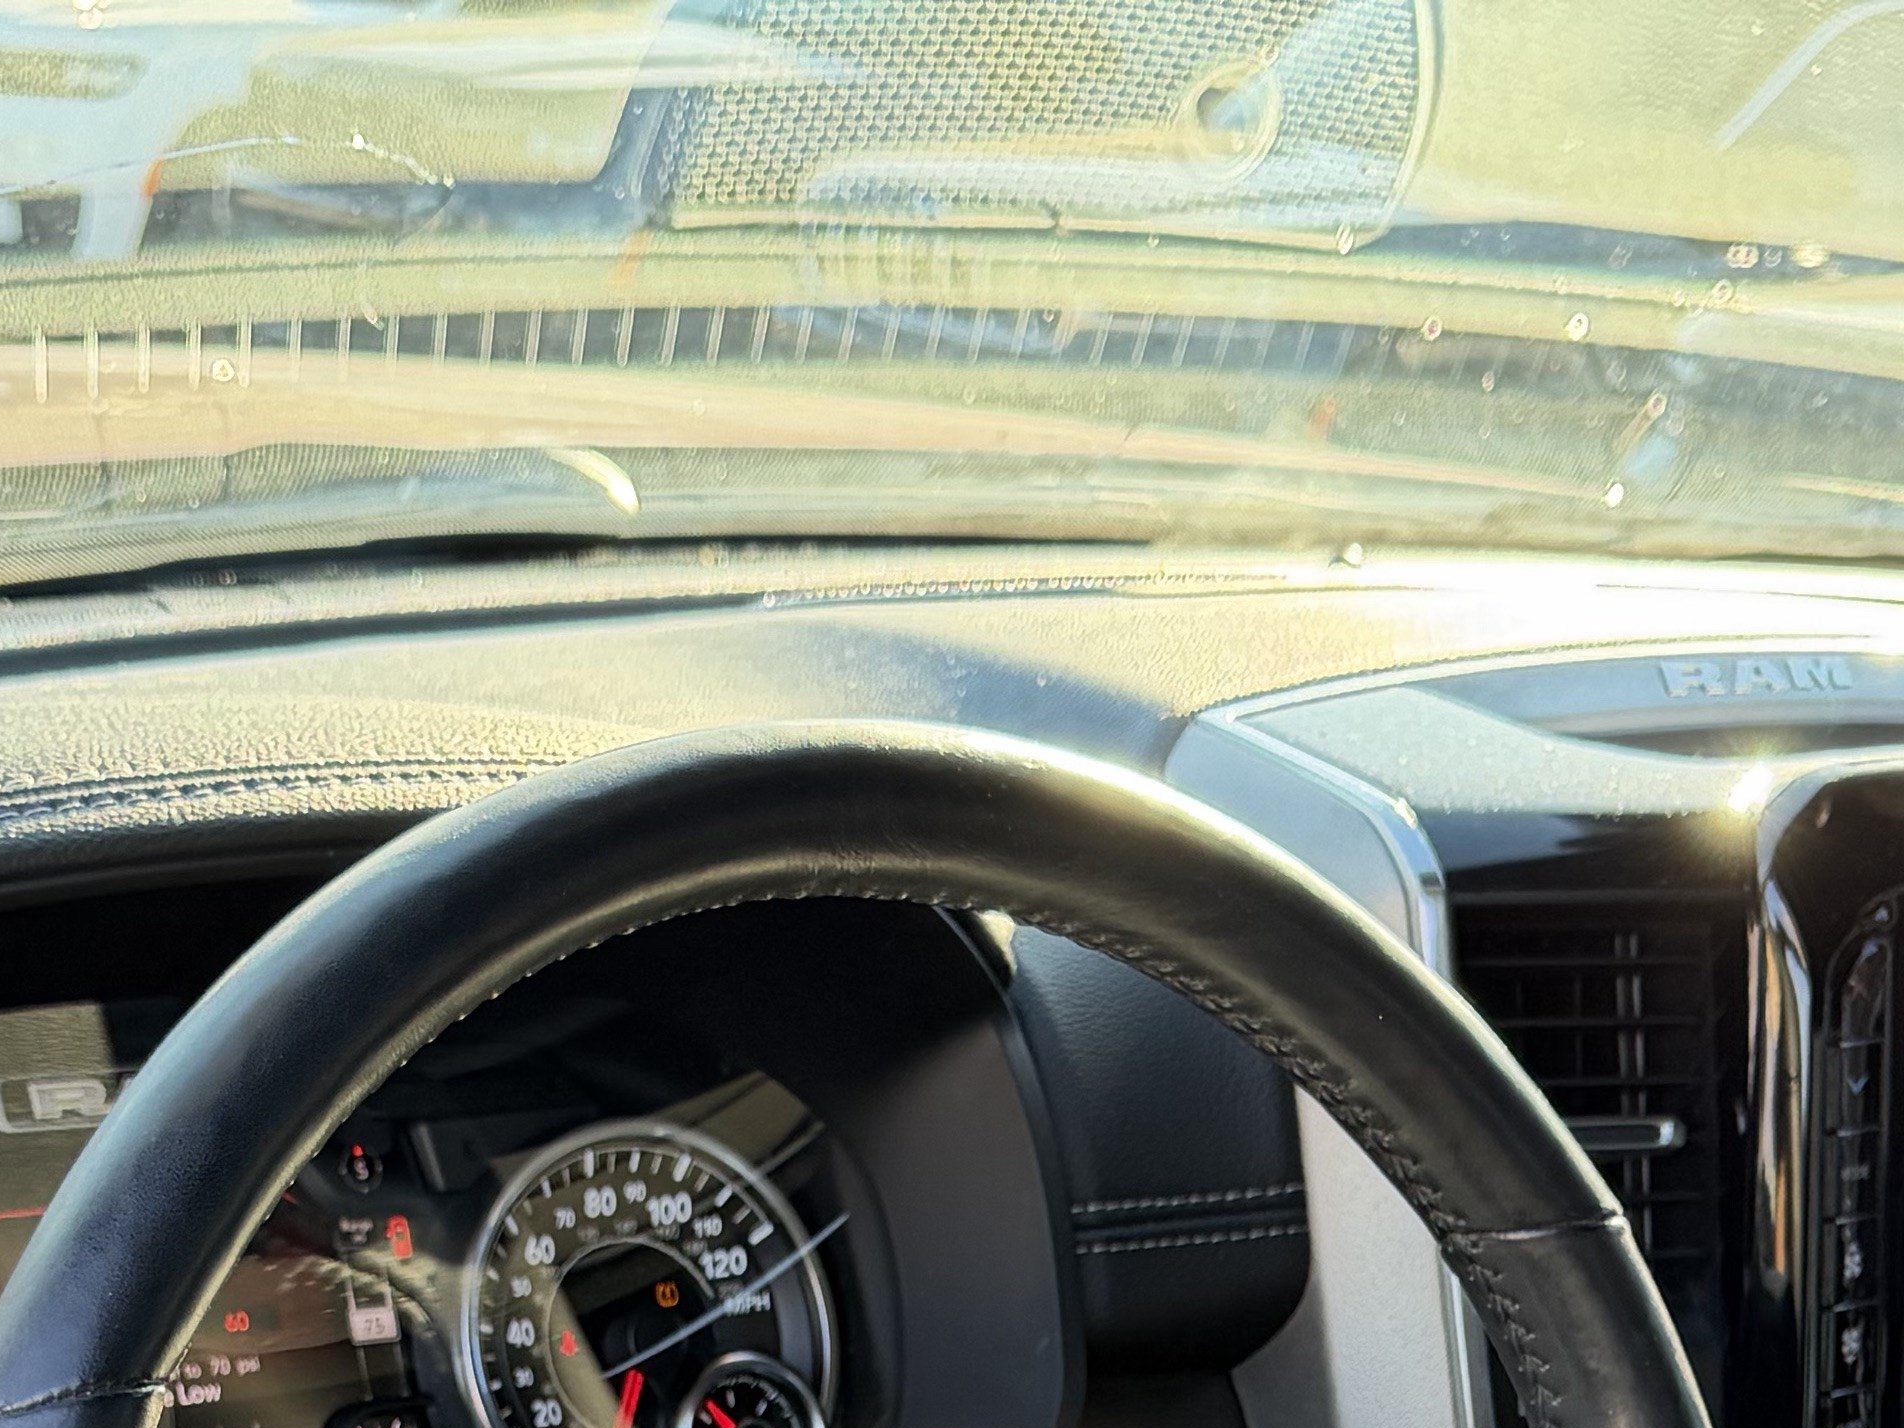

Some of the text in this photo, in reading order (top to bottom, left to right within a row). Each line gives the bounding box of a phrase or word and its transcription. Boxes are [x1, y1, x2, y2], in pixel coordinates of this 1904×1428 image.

[1658, 656, 1853, 698] RAM
[583, 1185, 617, 1219] 80
[623, 1179, 647, 1203] 90
[553, 1206, 577, 1230] 70
[646, 1190, 693, 1226] 100
[692, 1212, 723, 1238] 110
[524, 1234, 556, 1266] 60
[700, 1244, 748, 1281] 120
[506, 1317, 536, 1348] 40
[529, 1398, 563, 1428] 20
